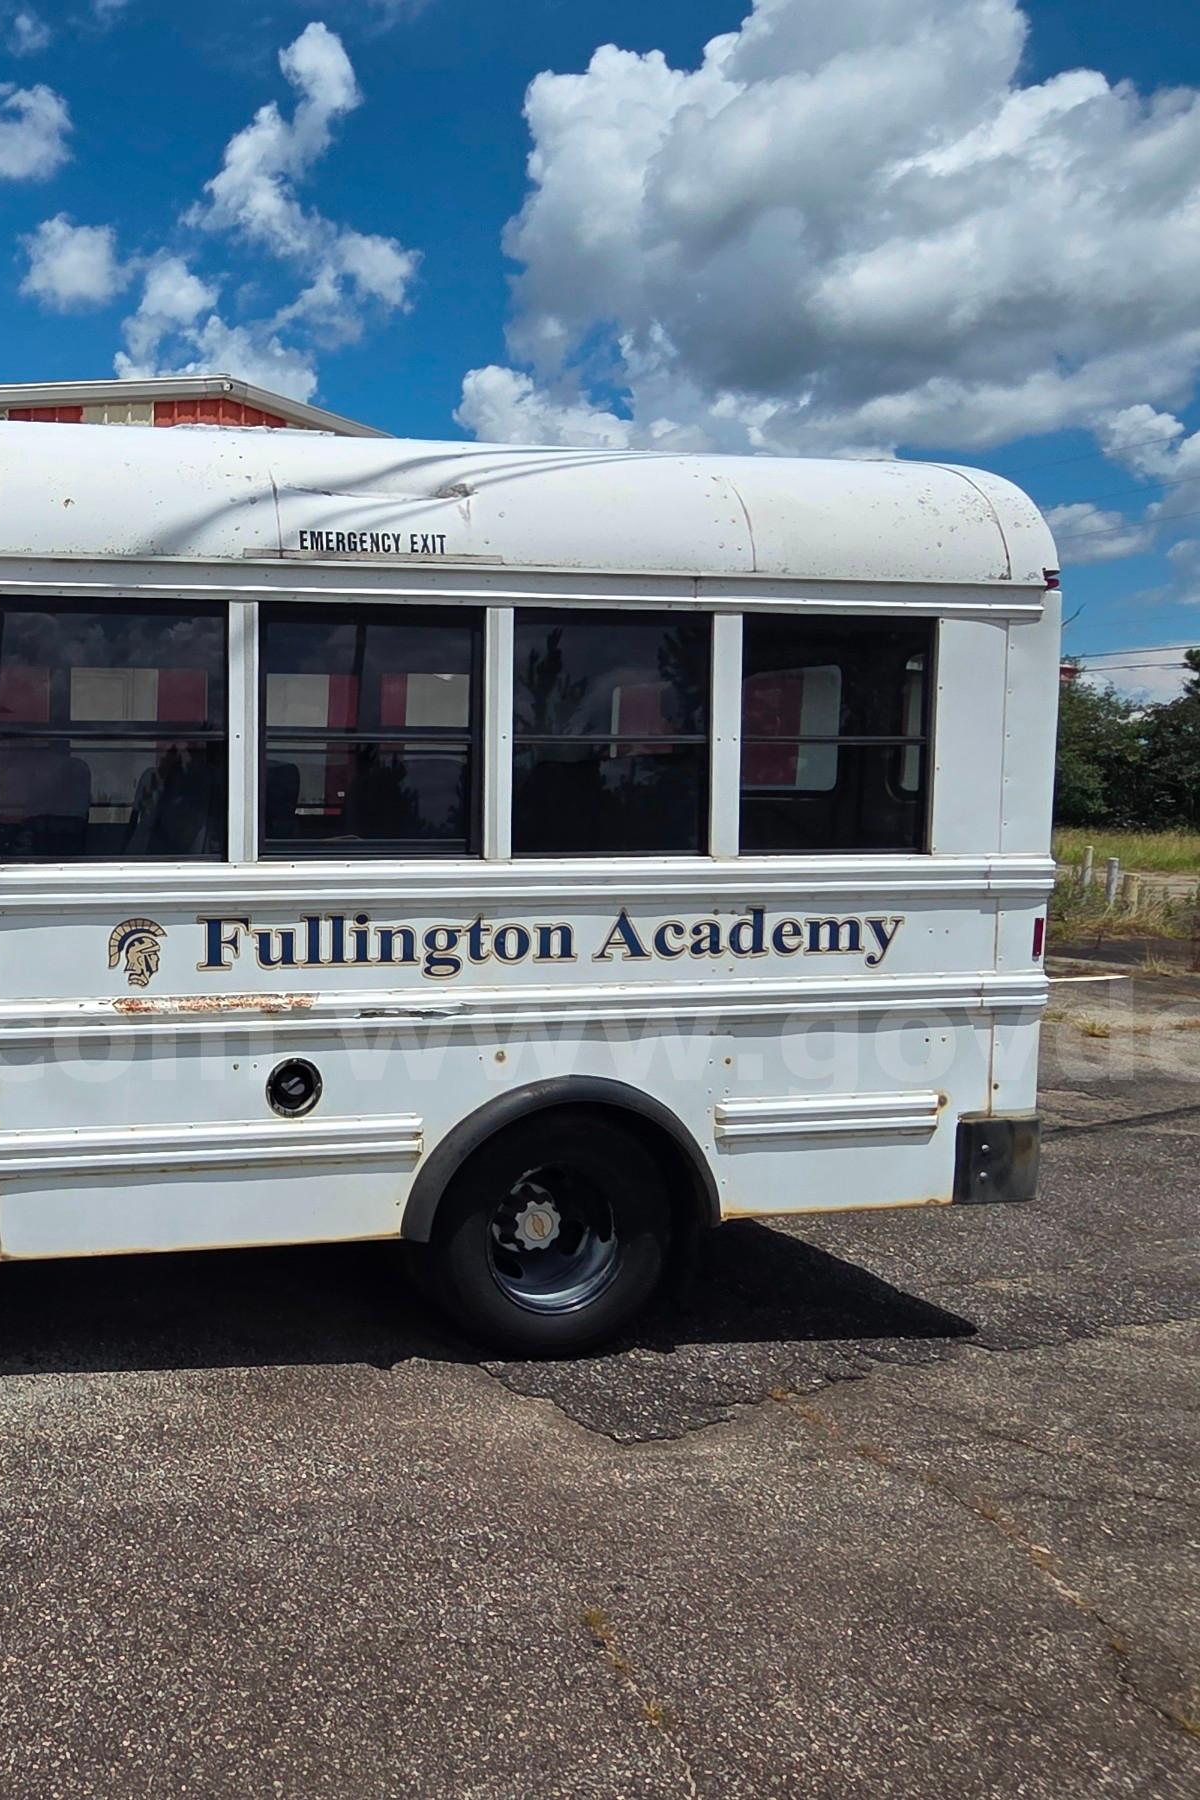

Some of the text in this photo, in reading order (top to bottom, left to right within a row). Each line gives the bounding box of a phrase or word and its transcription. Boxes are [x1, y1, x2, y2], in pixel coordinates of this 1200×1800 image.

[299, 530, 447, 555] EMERGENCY EXIT
[196, 904, 905, 980] Fullington Academy
